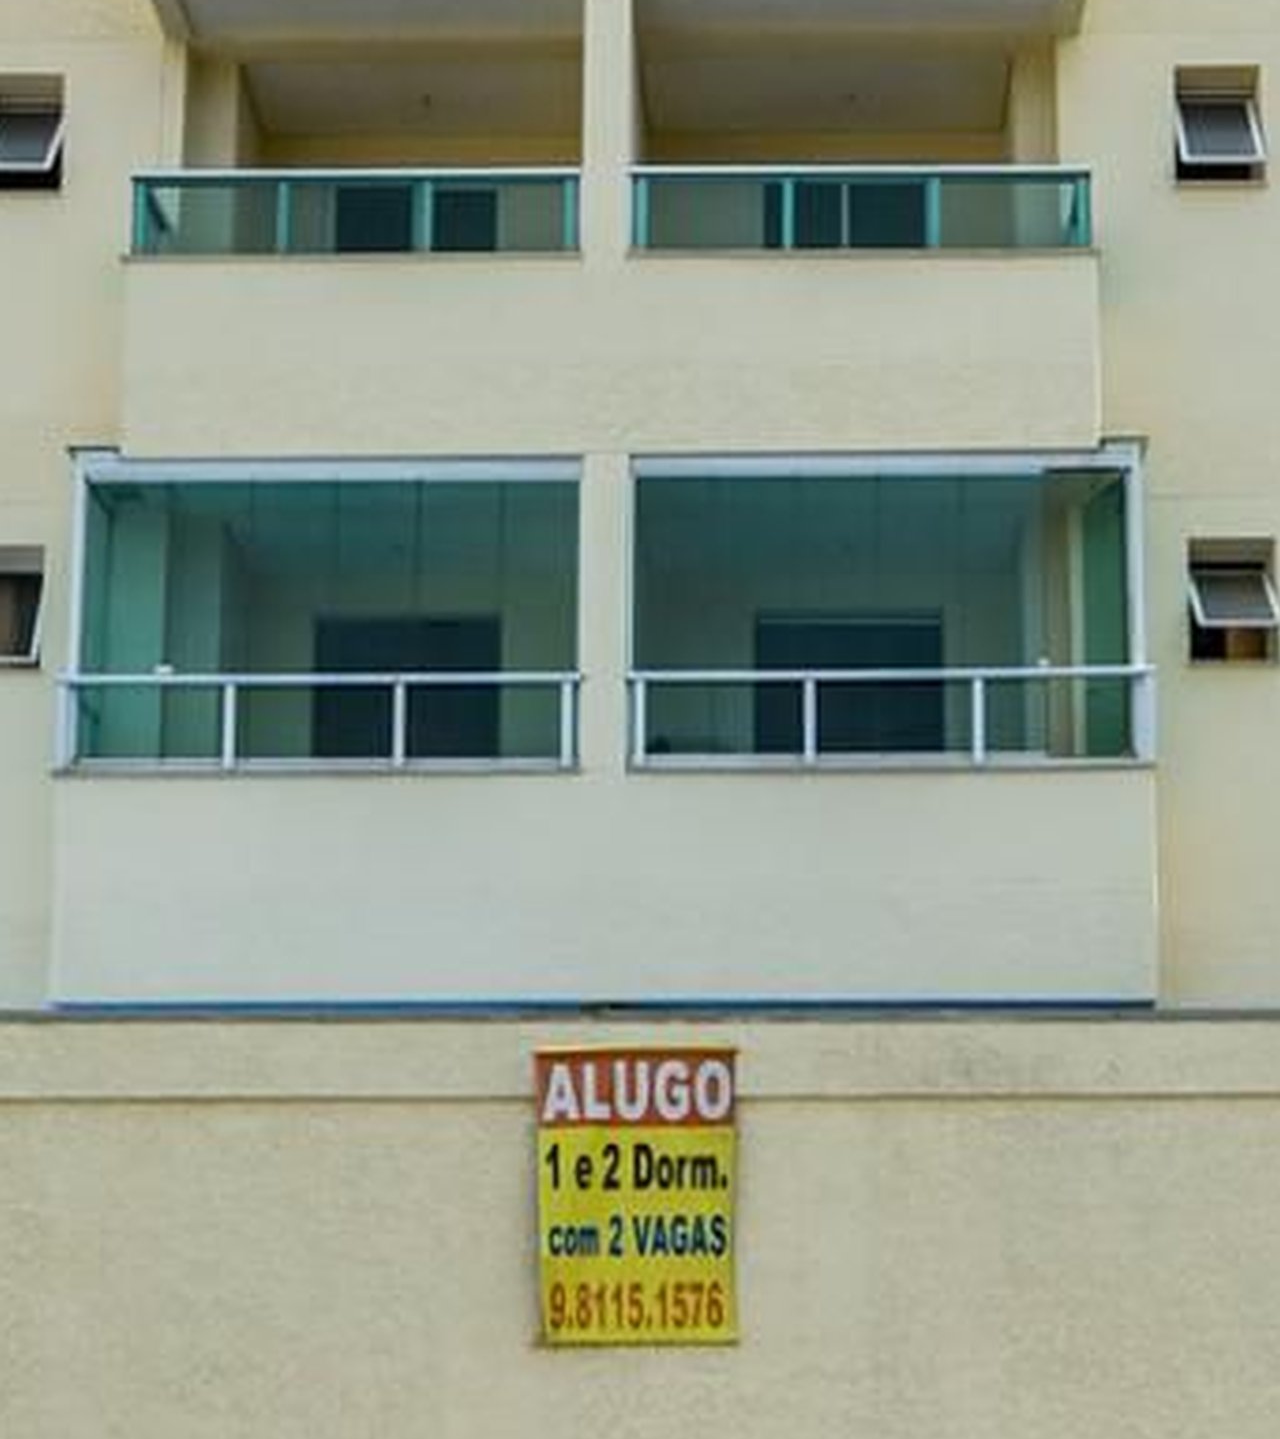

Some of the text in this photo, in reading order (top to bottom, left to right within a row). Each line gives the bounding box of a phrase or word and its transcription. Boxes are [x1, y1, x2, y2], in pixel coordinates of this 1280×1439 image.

[542, 1060, 731, 1121] ALUGO
[546, 1143, 728, 1189] 1 e 2 Dorm.
[548, 1215, 727, 1257] com 2 VAGAS
[549, 1282, 724, 1329] 9.8115.1576
